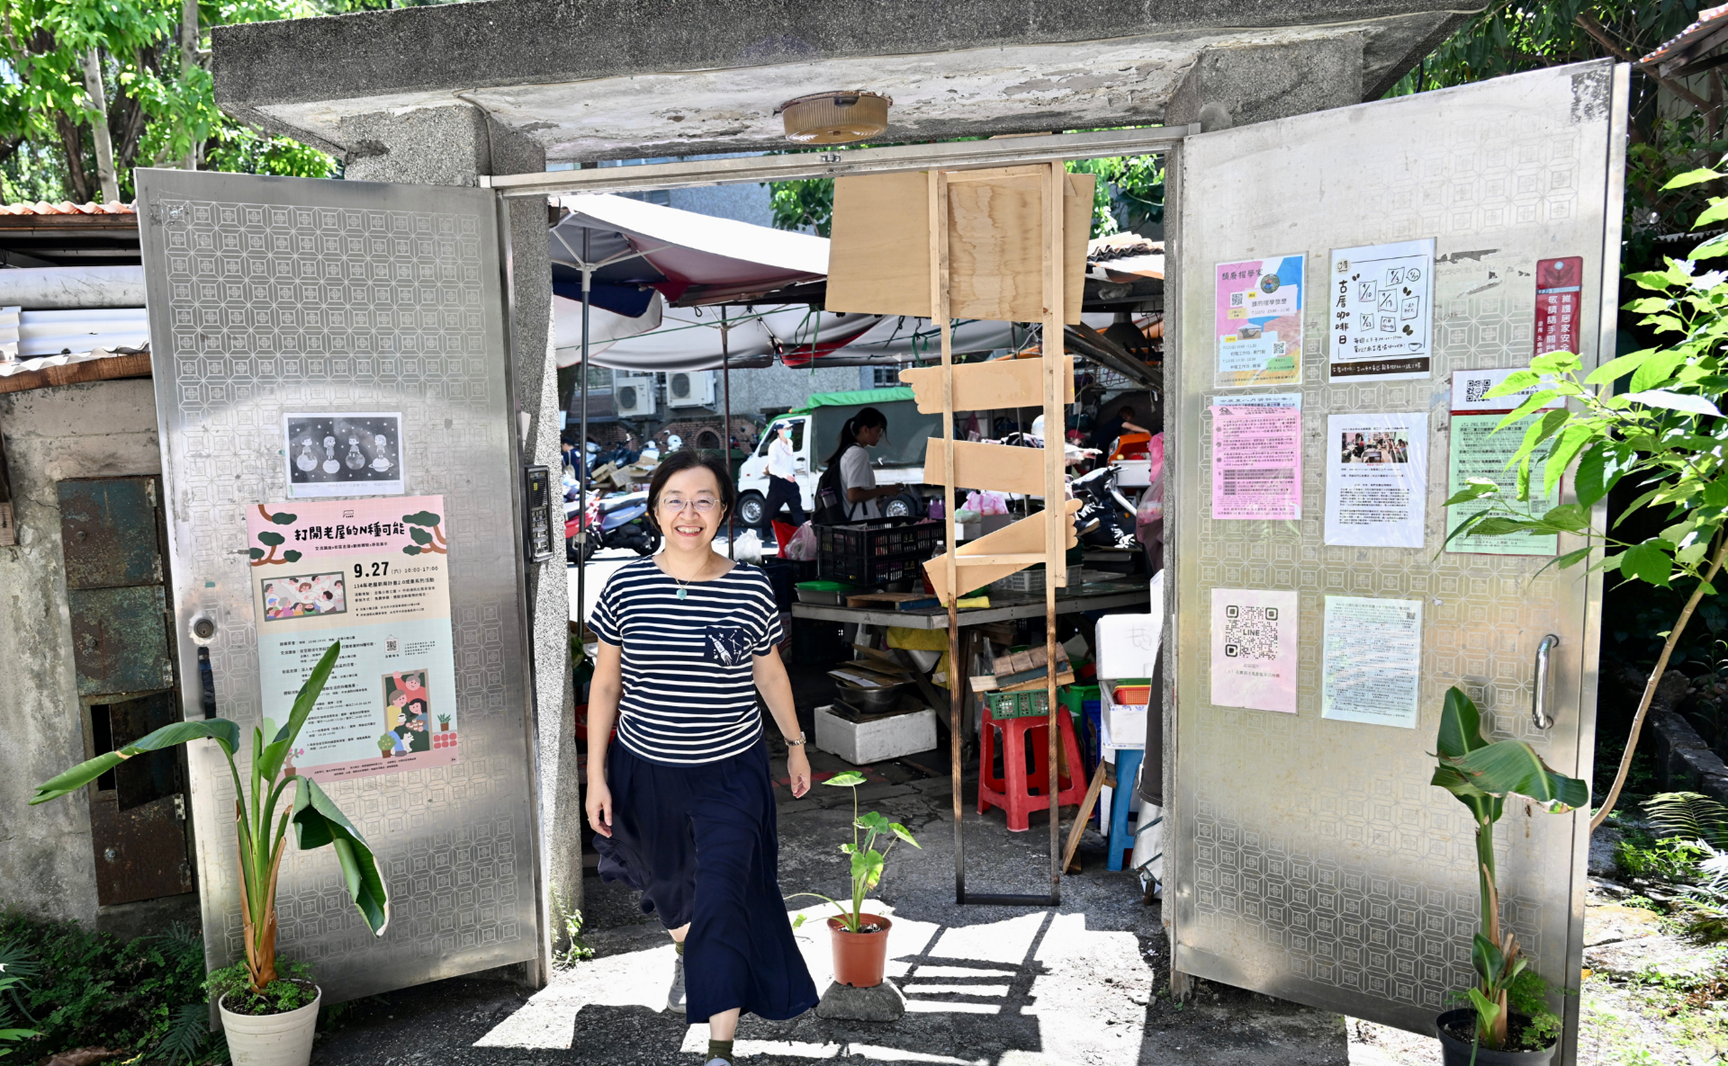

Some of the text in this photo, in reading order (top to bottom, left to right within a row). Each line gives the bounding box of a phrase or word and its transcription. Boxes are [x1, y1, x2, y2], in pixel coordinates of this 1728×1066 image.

[1545, 295, 1558, 352] 敬請隨手關門
[1559, 293, 1572, 352] 維護居家安全
[294, 521, 405, 541] 打開老屋的N種可能
[354, 561, 389, 578] 9.27
[404, 566, 439, 574] 10:00-17:00
[1242, 628, 1260, 637] LINE
